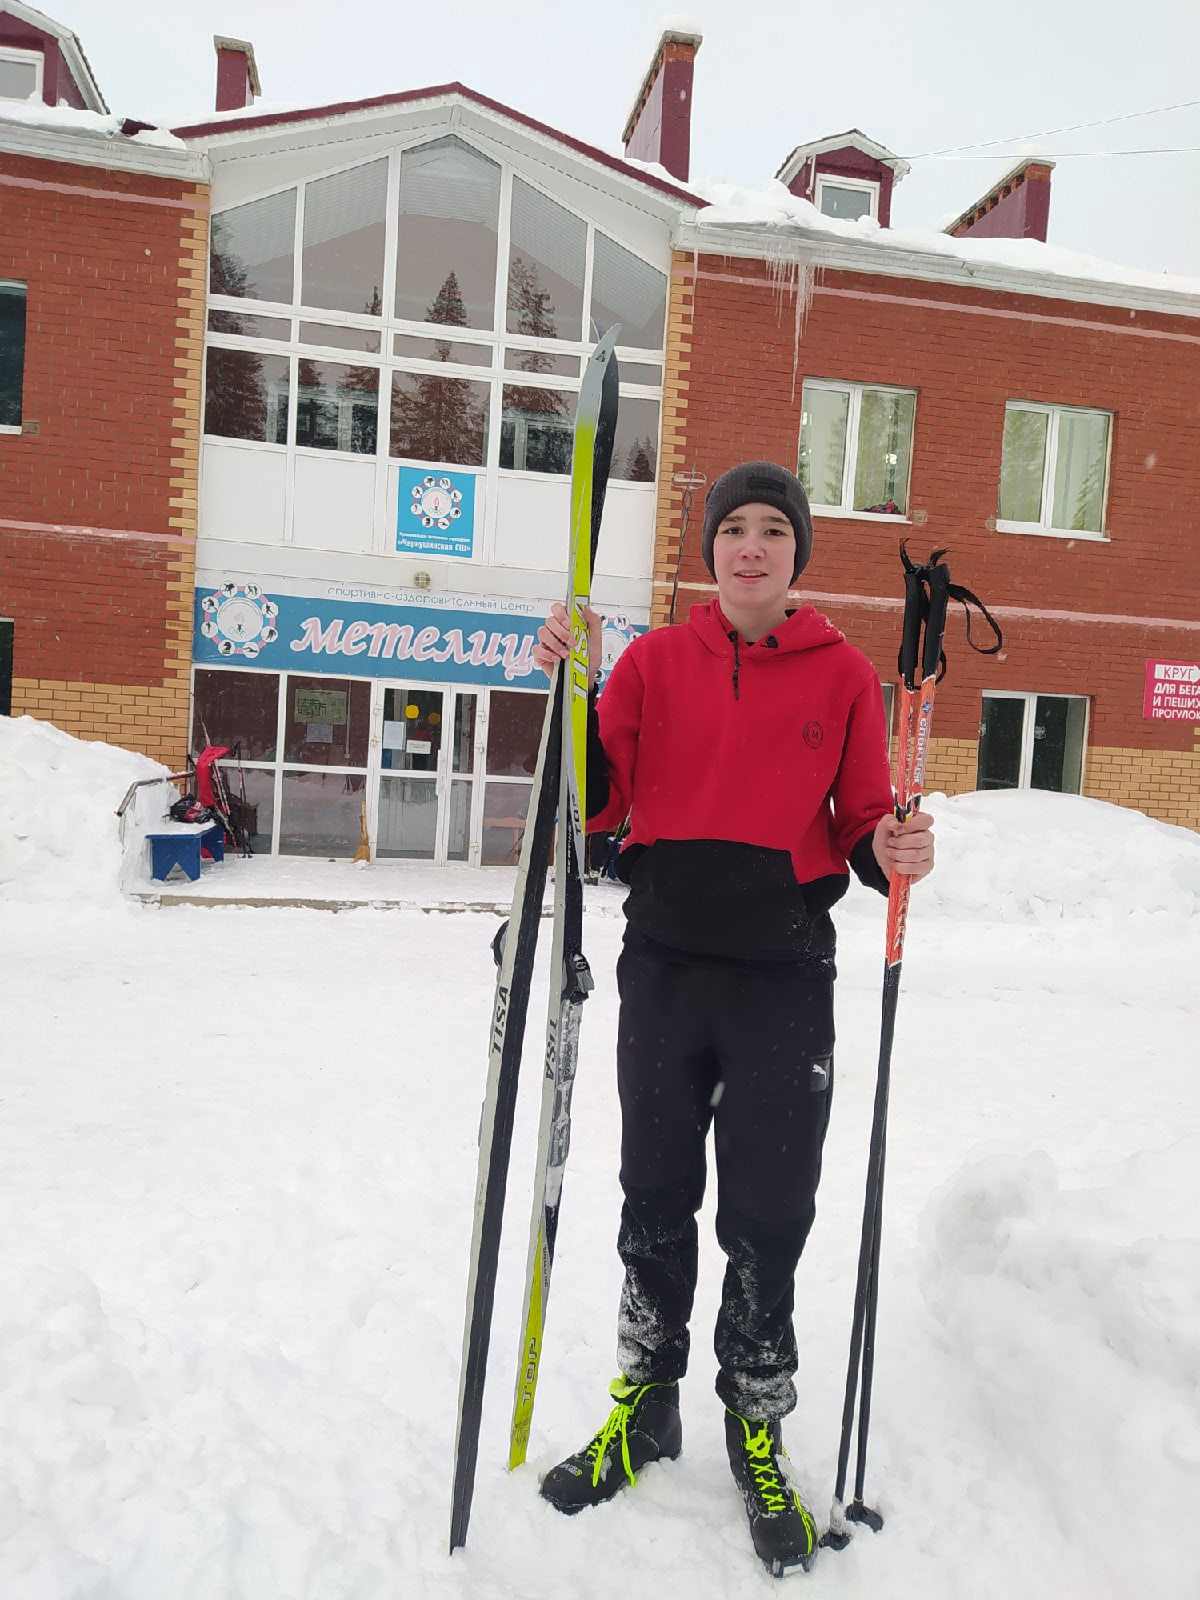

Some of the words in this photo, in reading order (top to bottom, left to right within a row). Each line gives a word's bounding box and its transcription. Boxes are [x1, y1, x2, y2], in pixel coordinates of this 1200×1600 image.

[500, 600, 535, 613] центр
[290, 617, 543, 681] метелиц
[1154, 683, 1176, 694] ДЛЯ
[1164, 666, 1194, 679] КРУГ
[1153, 696, 1161, 706] И
[492, 986, 509, 1054] TISA
[545, 1019, 559, 1081] TISA
[522, 1337, 537, 1407] TOP
